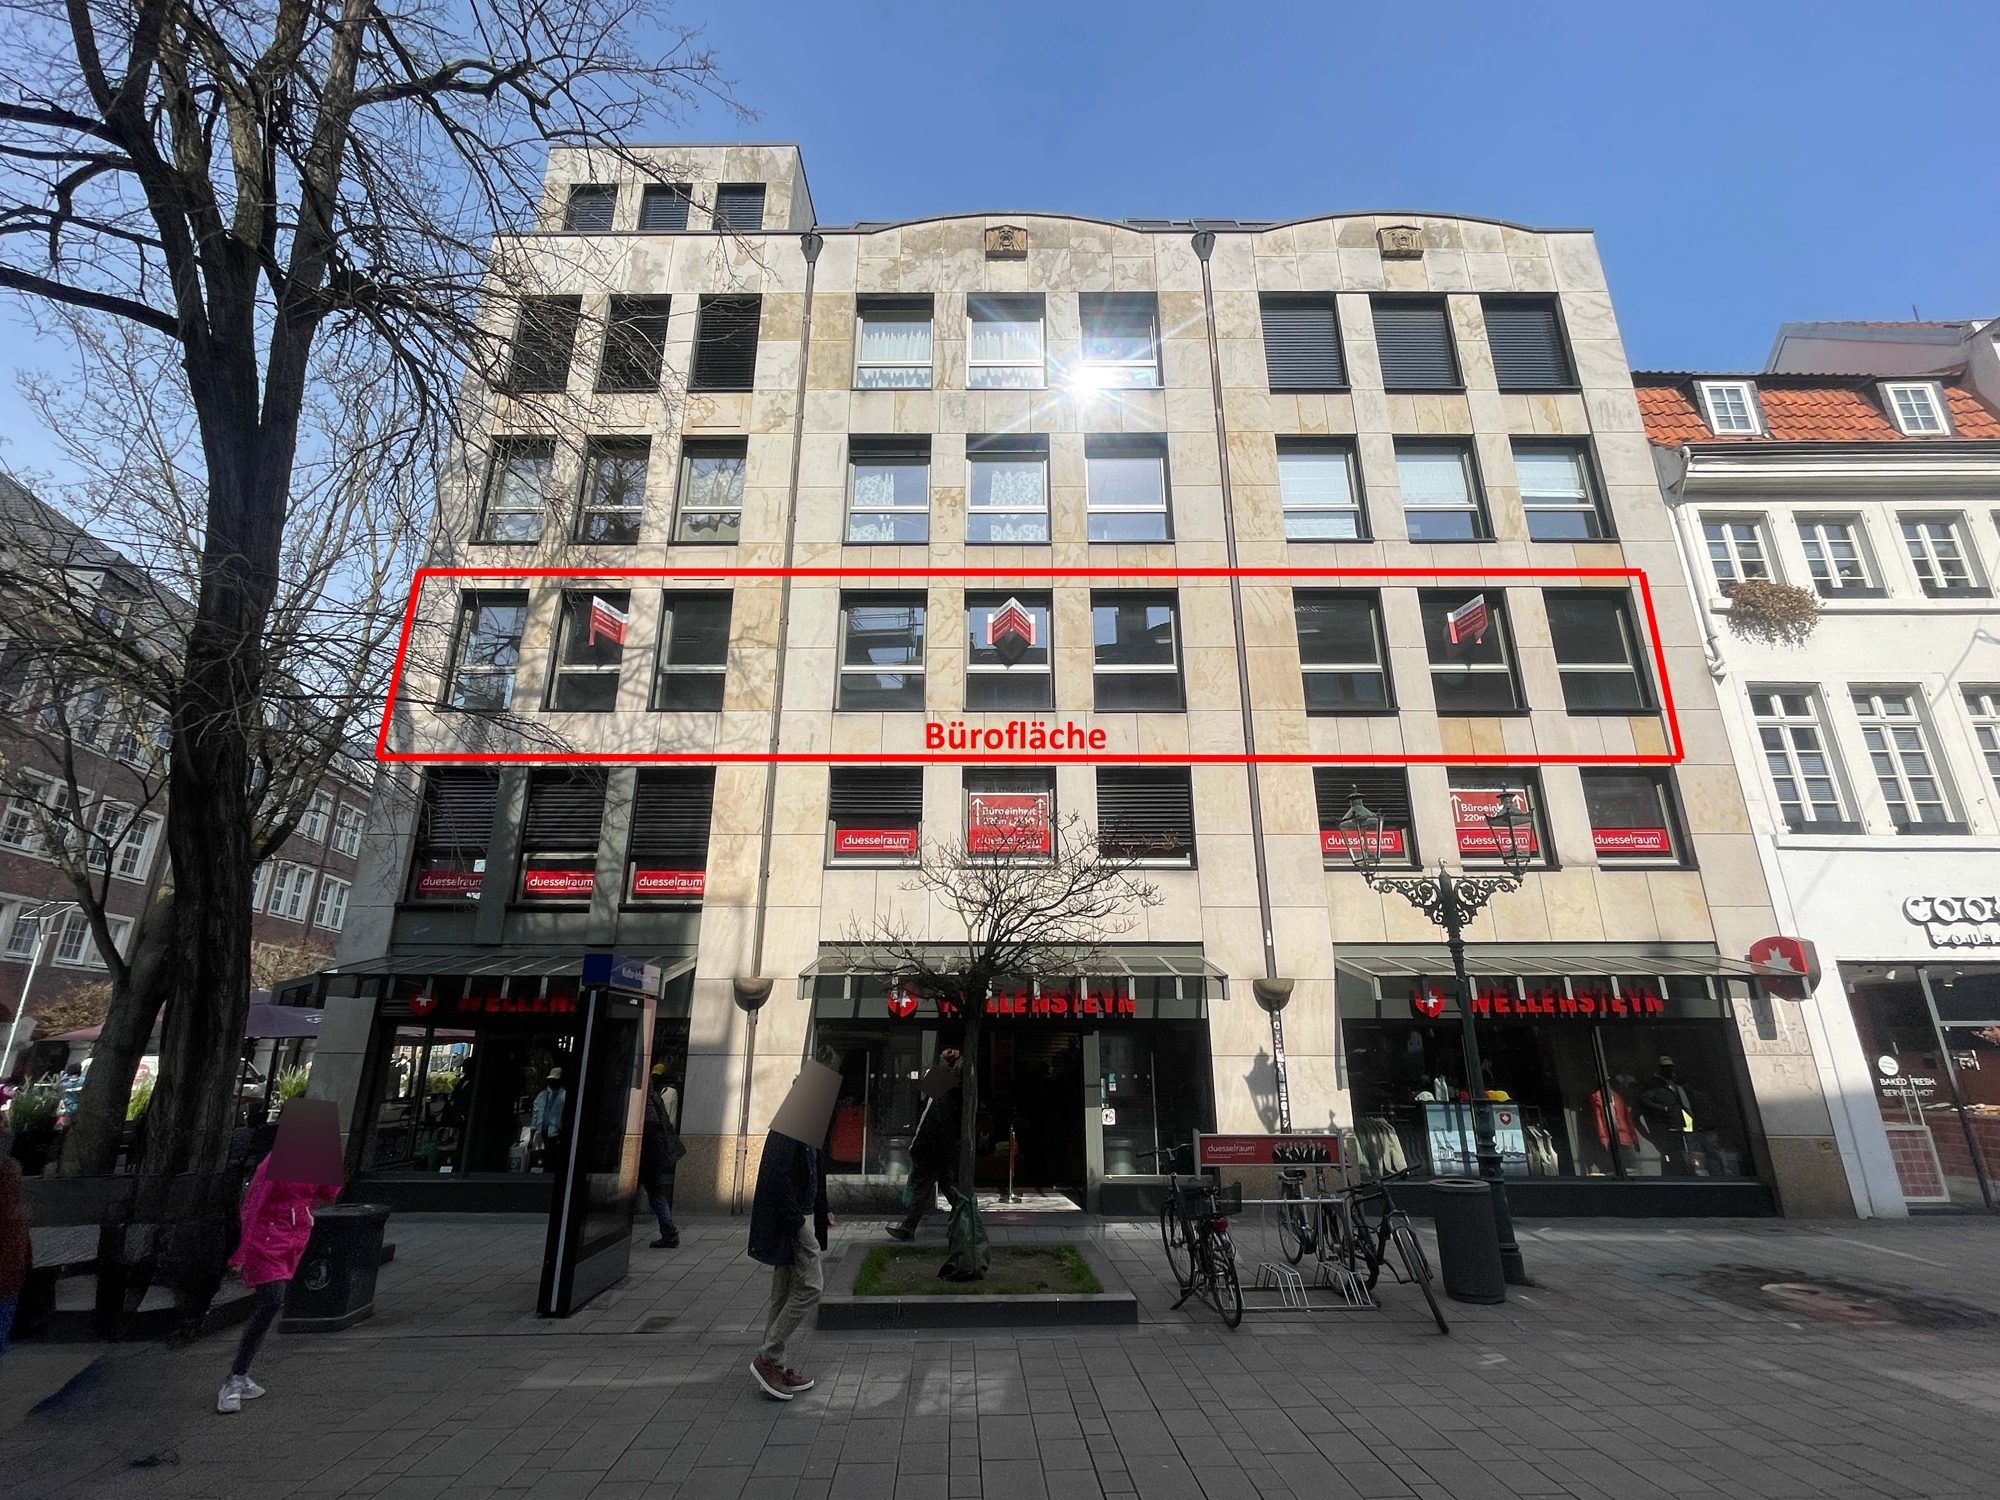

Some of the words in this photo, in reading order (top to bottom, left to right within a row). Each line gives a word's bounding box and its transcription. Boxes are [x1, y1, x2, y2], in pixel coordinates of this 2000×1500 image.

[844, 834, 909, 845] duesselraum
[1594, 833, 1660, 845] duesselraum
[530, 876, 594, 887] duesselraum
[639, 875, 702, 887] duesselraum
[1470, 988, 1665, 1014] WELLENSTEYN
[1879, 1078, 1908, 1086] BAKED
[1882, 1089, 1915, 1097] SERVED
[1917, 1089, 1935, 1097] HOT
[1207, 1143, 1256, 1153] duesselraum
